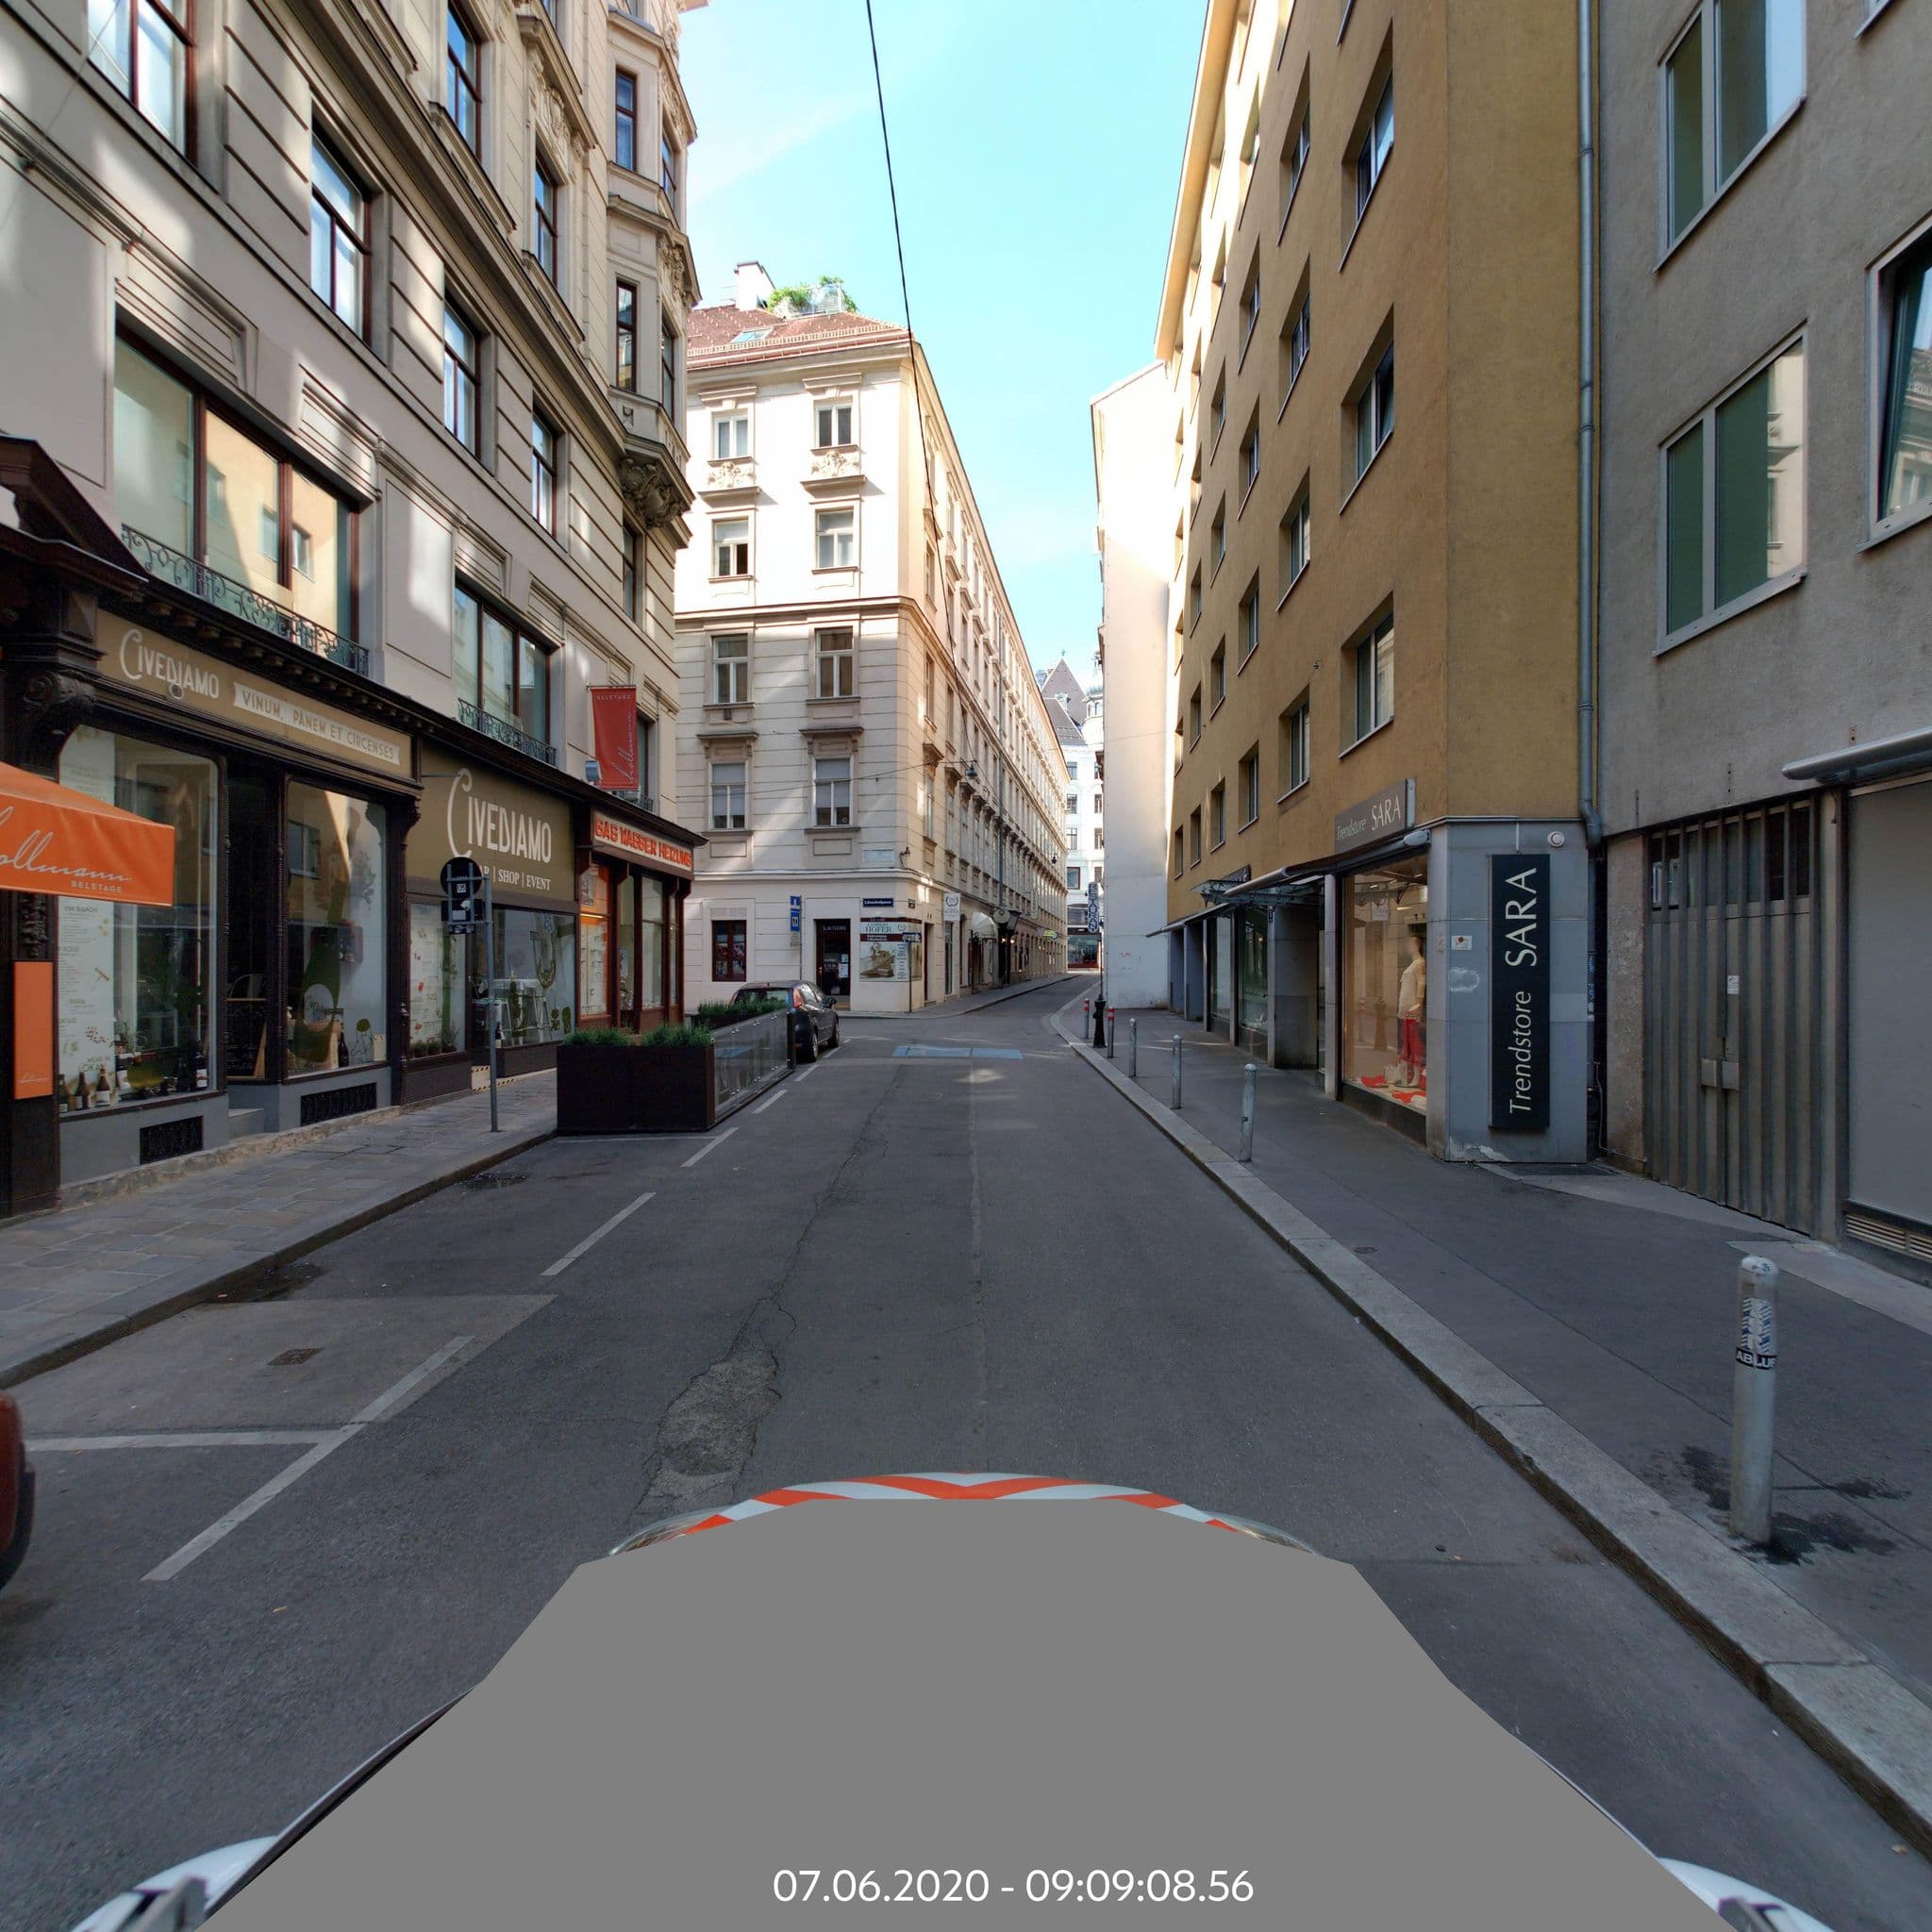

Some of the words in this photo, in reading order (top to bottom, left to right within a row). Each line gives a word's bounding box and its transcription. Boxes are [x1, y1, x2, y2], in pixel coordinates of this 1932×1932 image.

[120, 628, 219, 699] CIVEDIAMO
[293, 710, 326, 735] PANEM
[330, 726, 341, 741] ET
[346, 731, 394, 759] CIRCENSES
[447, 767, 552, 864] CIVEDIAMO
[1337, 818, 1367, 842] Trendstore
[1371, 794, 1402, 831] SARA
[595, 820, 618, 843] GAS
[620, 825, 658, 858] WASSER
[658, 842, 693, 871] HEIZUNG
[71, 880, 123, 893] BELETAGE
[498, 868, 520, 885] SHOP
[526, 874, 552, 891] EVENT
[1505, 867, 1537, 967] SARA
[1508, 991, 1532, 1114] Trendstore
